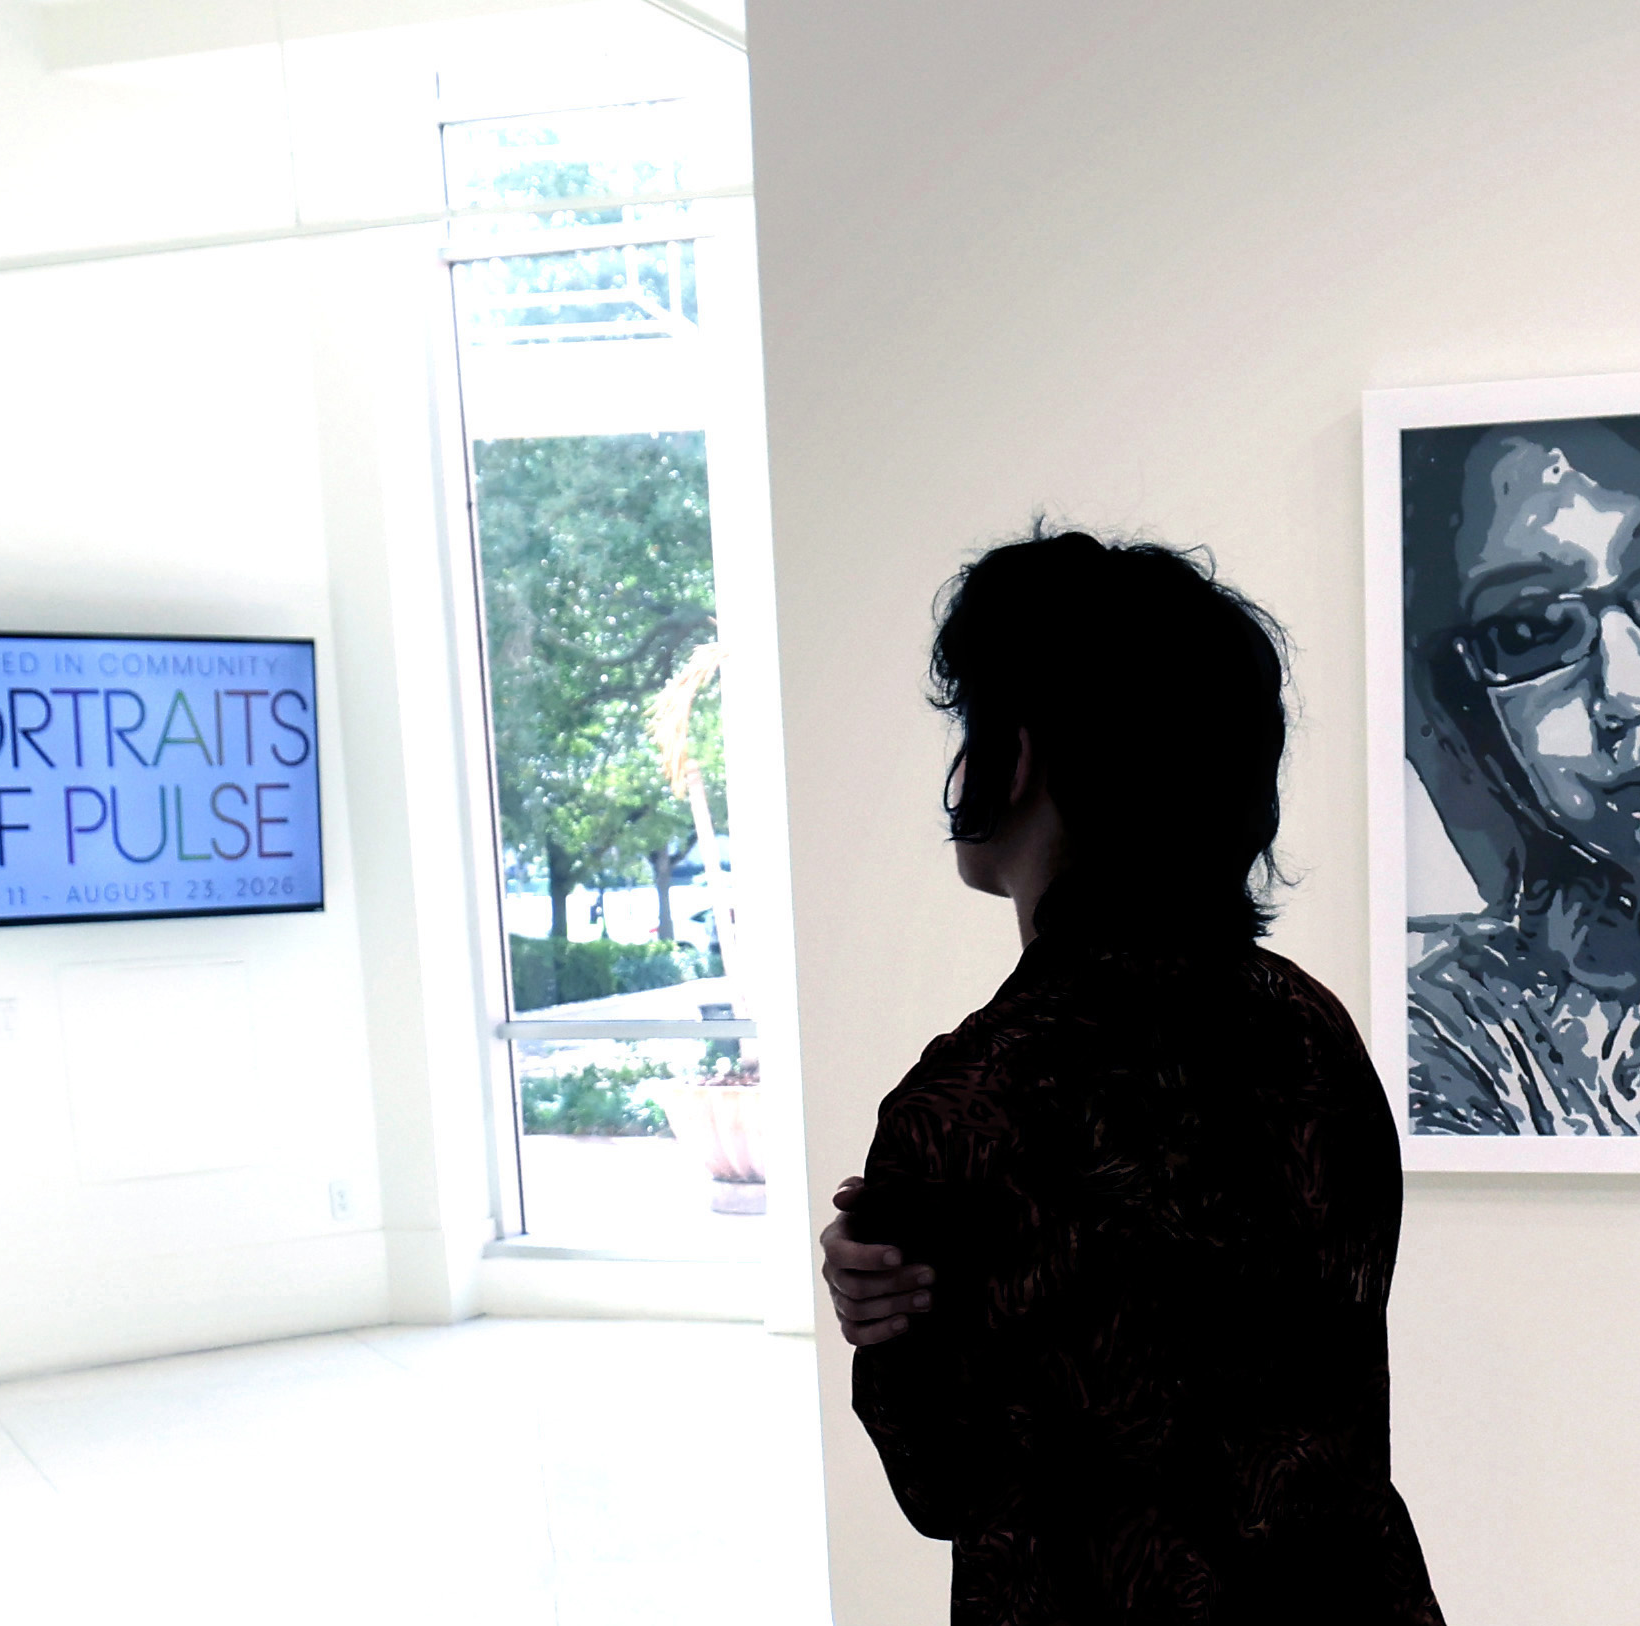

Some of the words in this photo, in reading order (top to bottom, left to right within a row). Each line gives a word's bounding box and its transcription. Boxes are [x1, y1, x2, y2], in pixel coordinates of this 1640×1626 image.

[54, 651, 83, 675] IN
[98, 652, 279, 677] COMMUNITY
[63, 782, 293, 865] PULSE
[8, 886, 26, 906] 11
[65, 880, 171, 904] AUGUST
[186, 878, 222, 901] 23,
[236, 876, 294, 898] 2026
